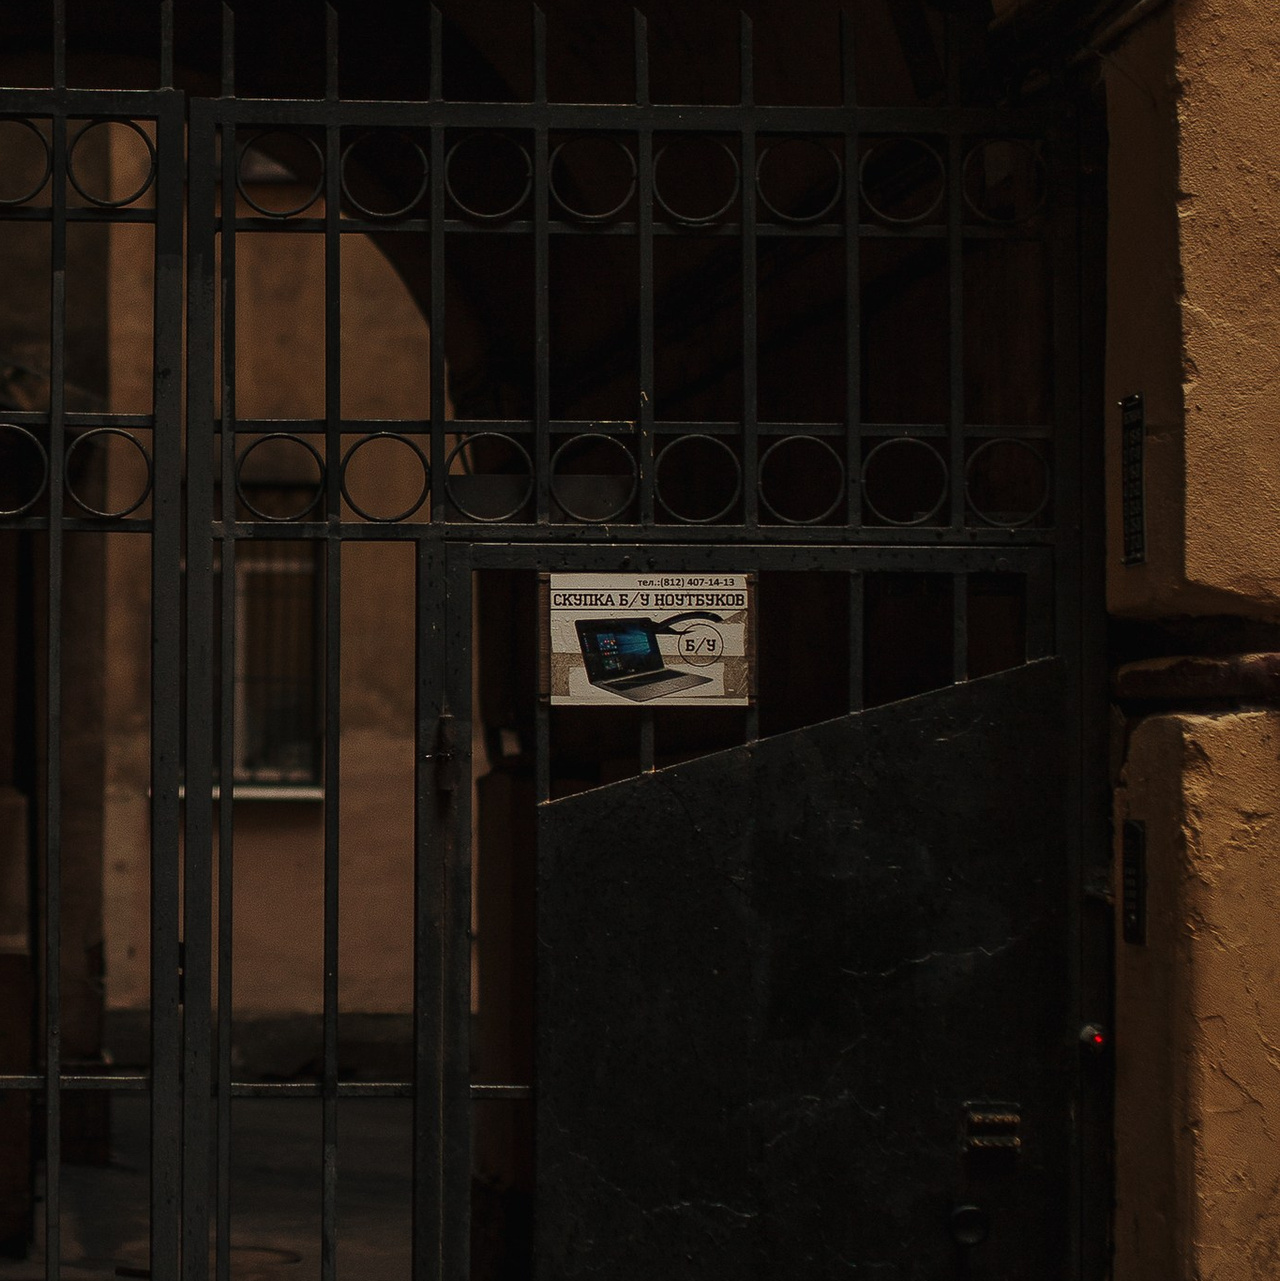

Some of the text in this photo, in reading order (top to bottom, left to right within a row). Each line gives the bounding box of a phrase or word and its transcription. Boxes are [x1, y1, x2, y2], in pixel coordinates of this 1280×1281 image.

[687, 578, 735, 587] 407-14-13
[553, 592, 745, 608] СКУПКА Б/У НОУТБУКОВ
[685, 637, 717, 654] Б/У
